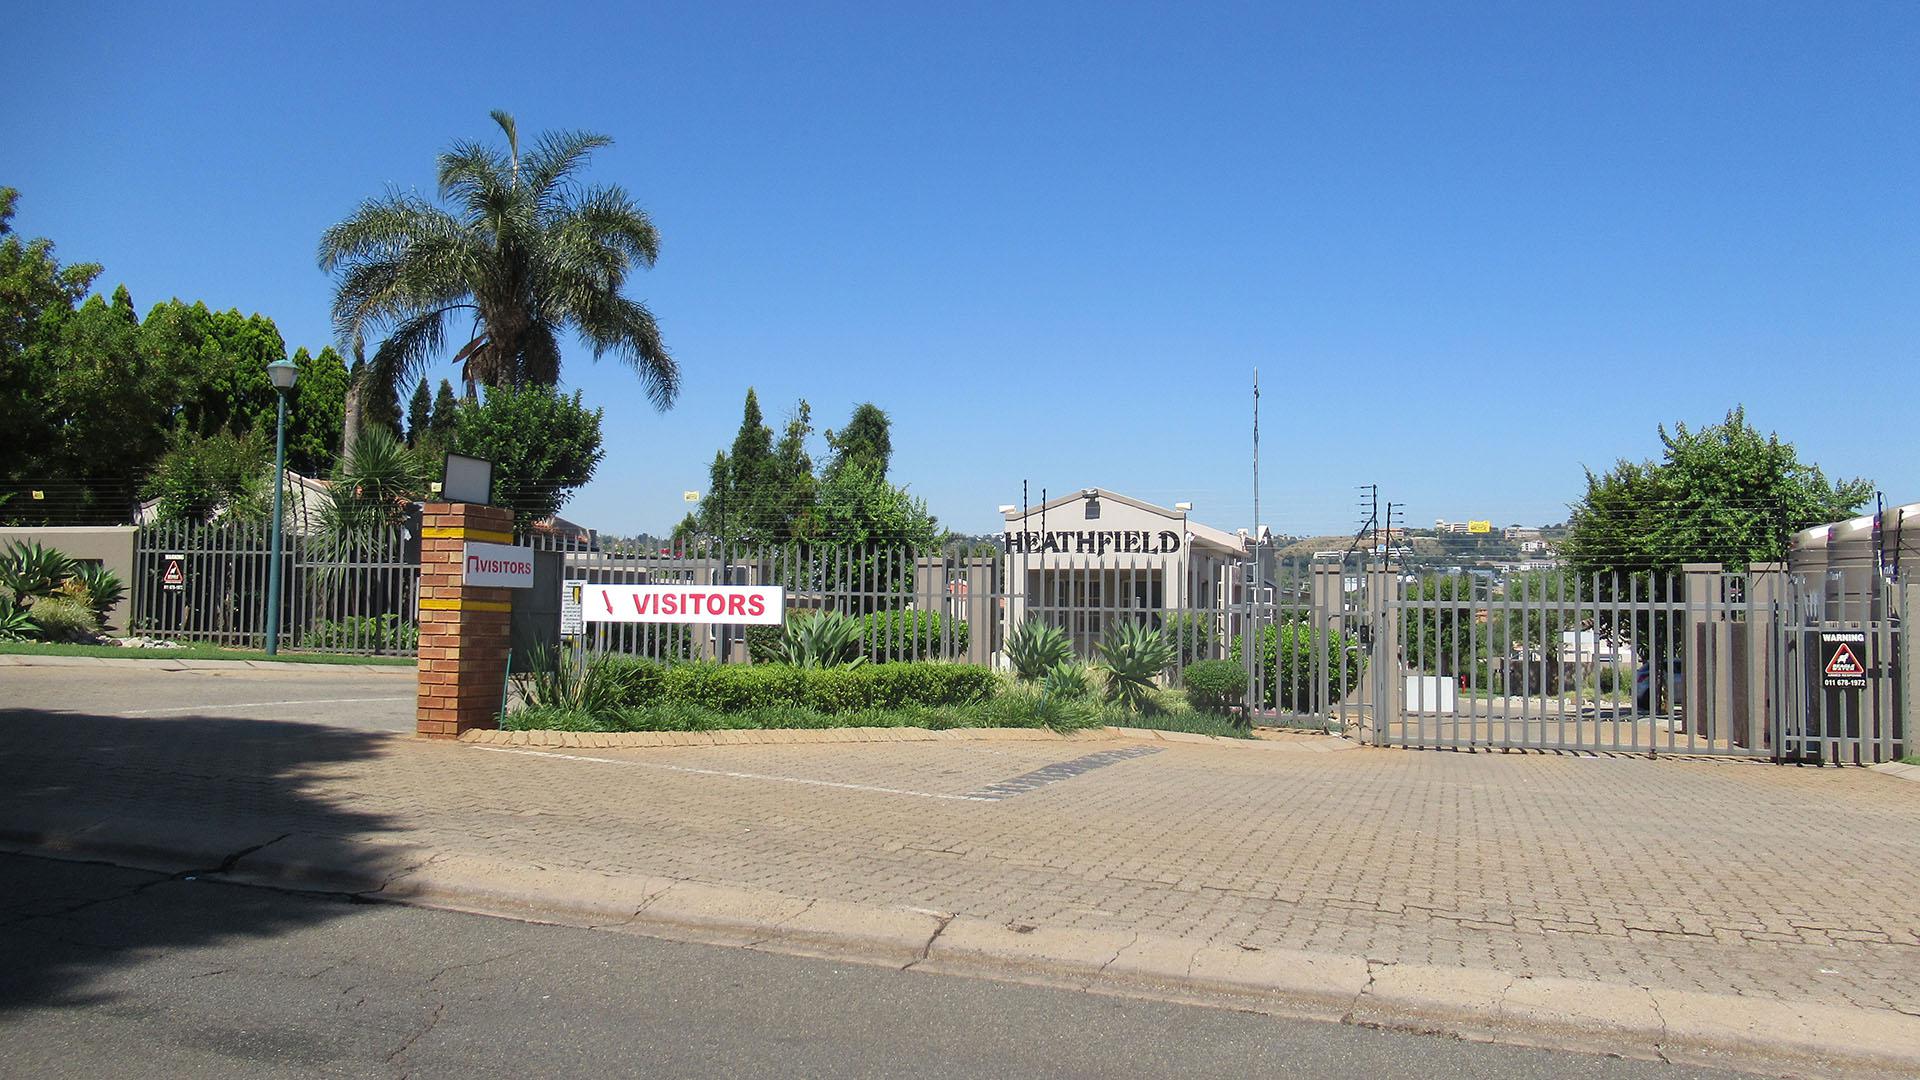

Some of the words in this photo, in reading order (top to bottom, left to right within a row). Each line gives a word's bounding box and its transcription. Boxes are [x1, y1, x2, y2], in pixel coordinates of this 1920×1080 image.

[1005, 530, 1181, 557] HEATHFIELD
[480, 559, 532, 575] VISITORS
[632, 593, 765, 616] VISITORS
[1822, 633, 1865, 642] WARNING
